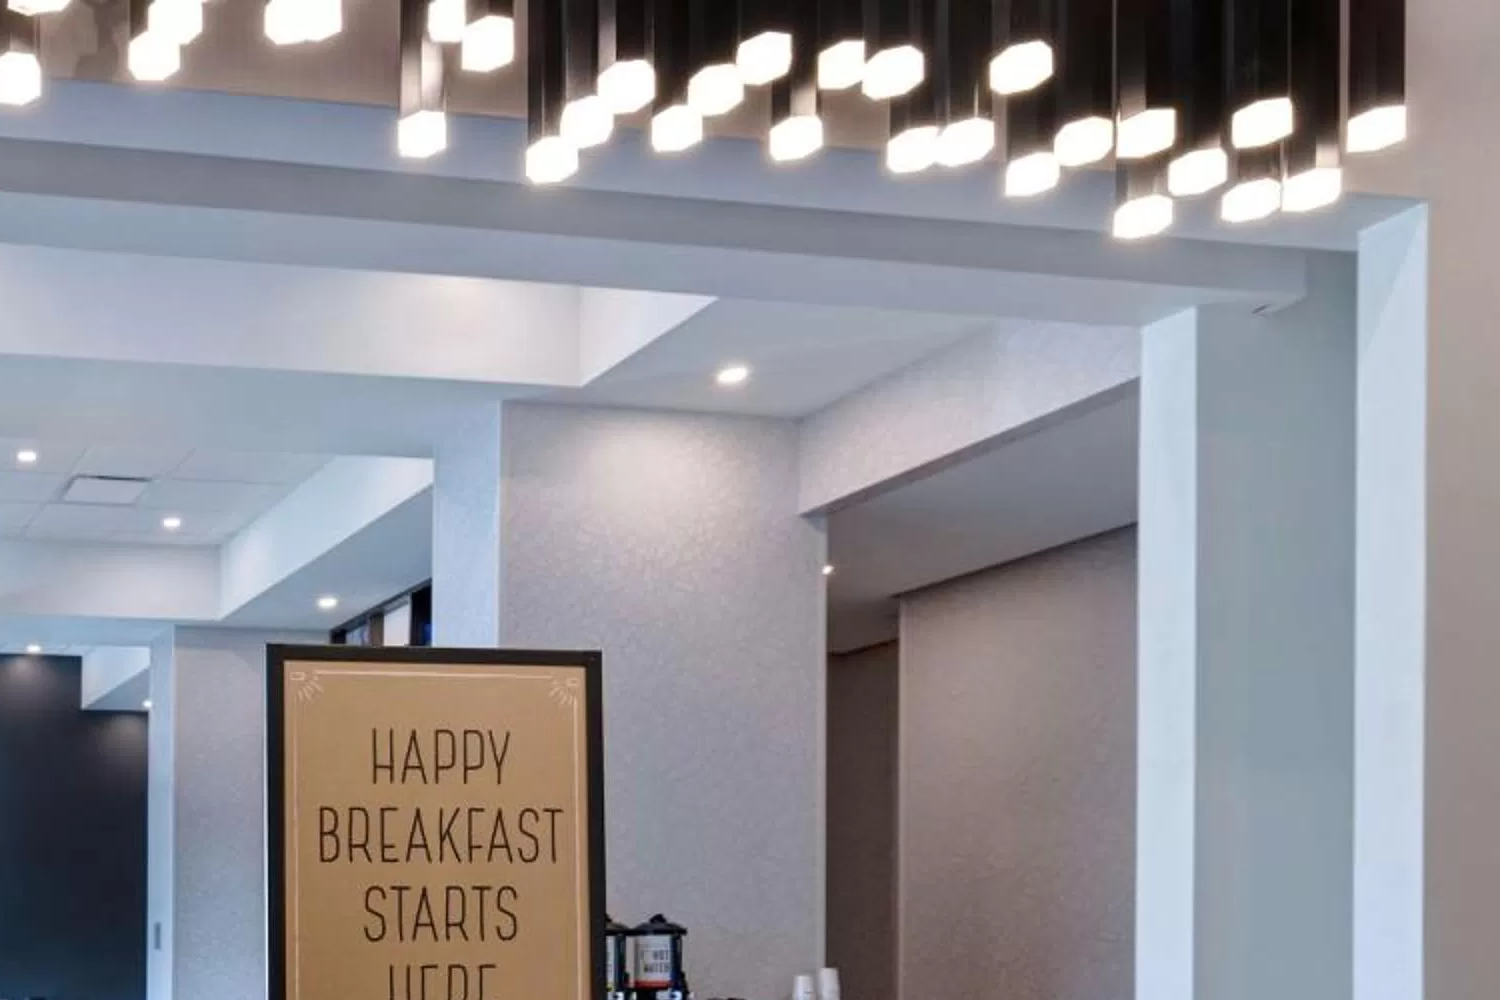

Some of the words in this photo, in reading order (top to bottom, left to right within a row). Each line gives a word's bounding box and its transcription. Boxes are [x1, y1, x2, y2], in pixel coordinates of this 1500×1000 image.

[371, 727, 511, 785] HAPPY
[319, 806, 564, 864] BREAKFAST
[364, 885, 519, 942] STARTS
